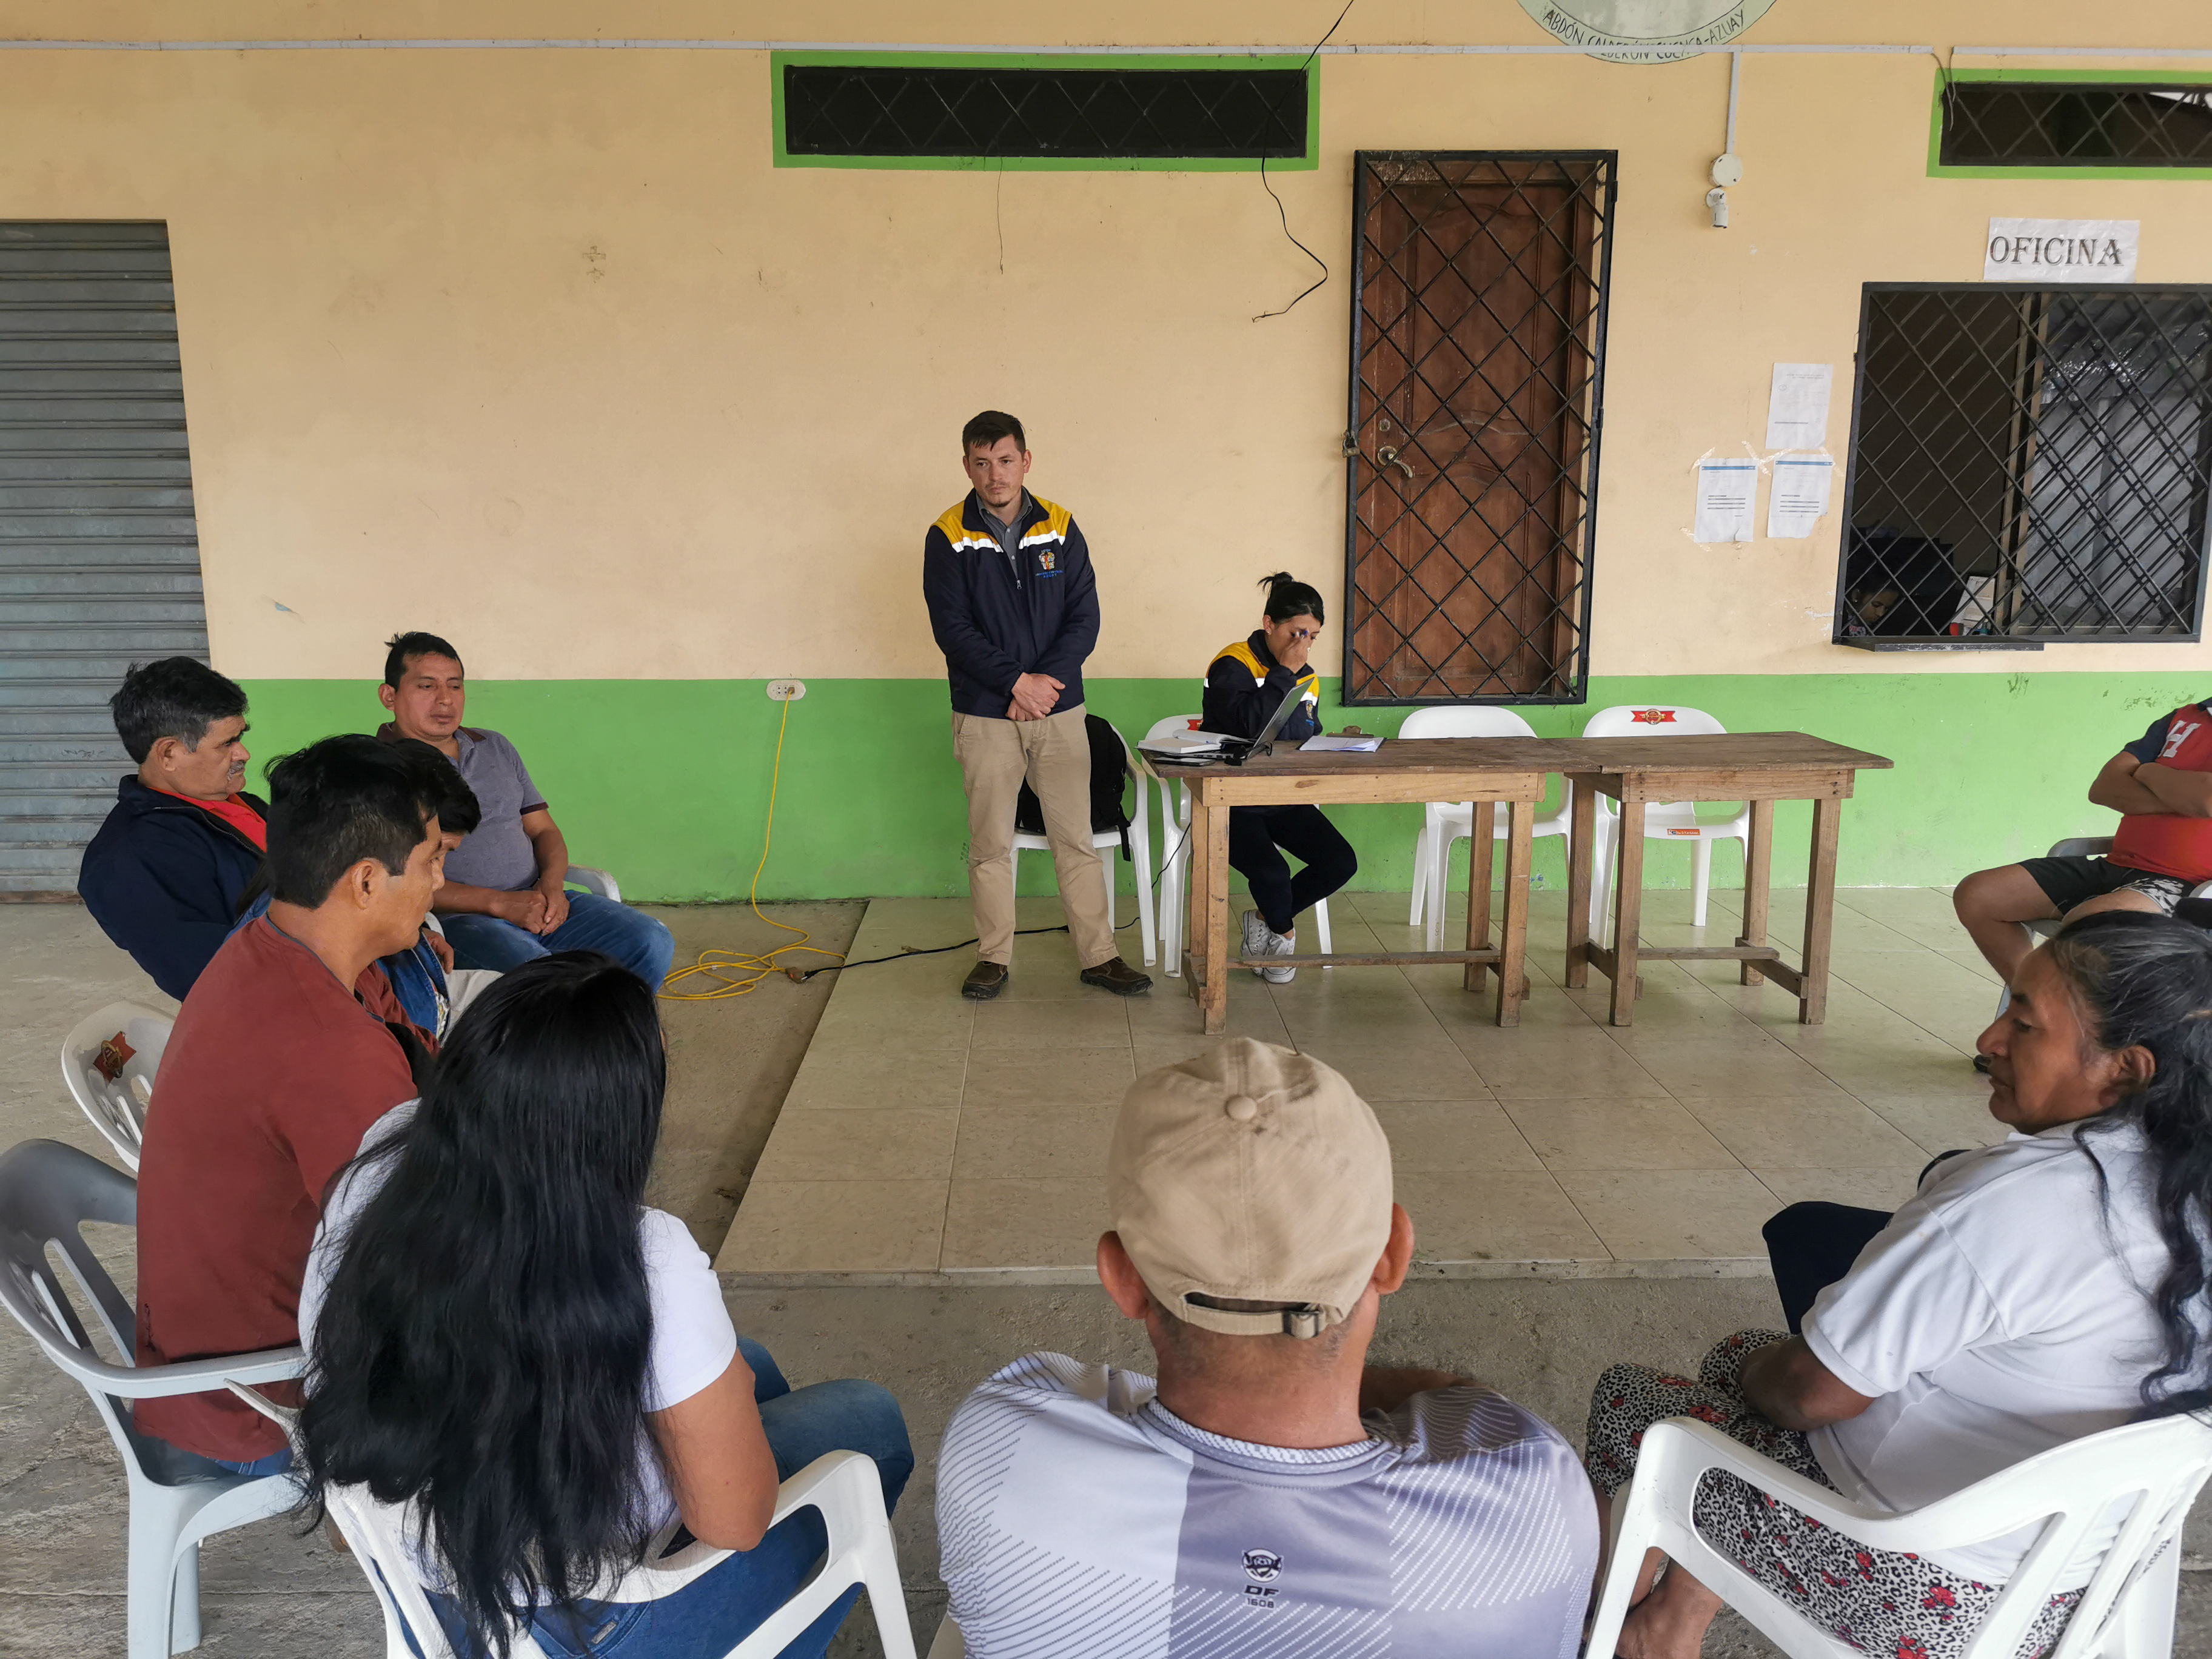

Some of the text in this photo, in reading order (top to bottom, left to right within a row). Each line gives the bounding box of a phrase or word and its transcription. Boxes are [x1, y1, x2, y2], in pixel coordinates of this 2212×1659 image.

[1543, 9, 1585, 45] ABDÓN
[1989, 236, 2124, 266] OFICINA
[2157, 720, 2202, 758] H
[1244, 1585, 1279, 1596] DF
